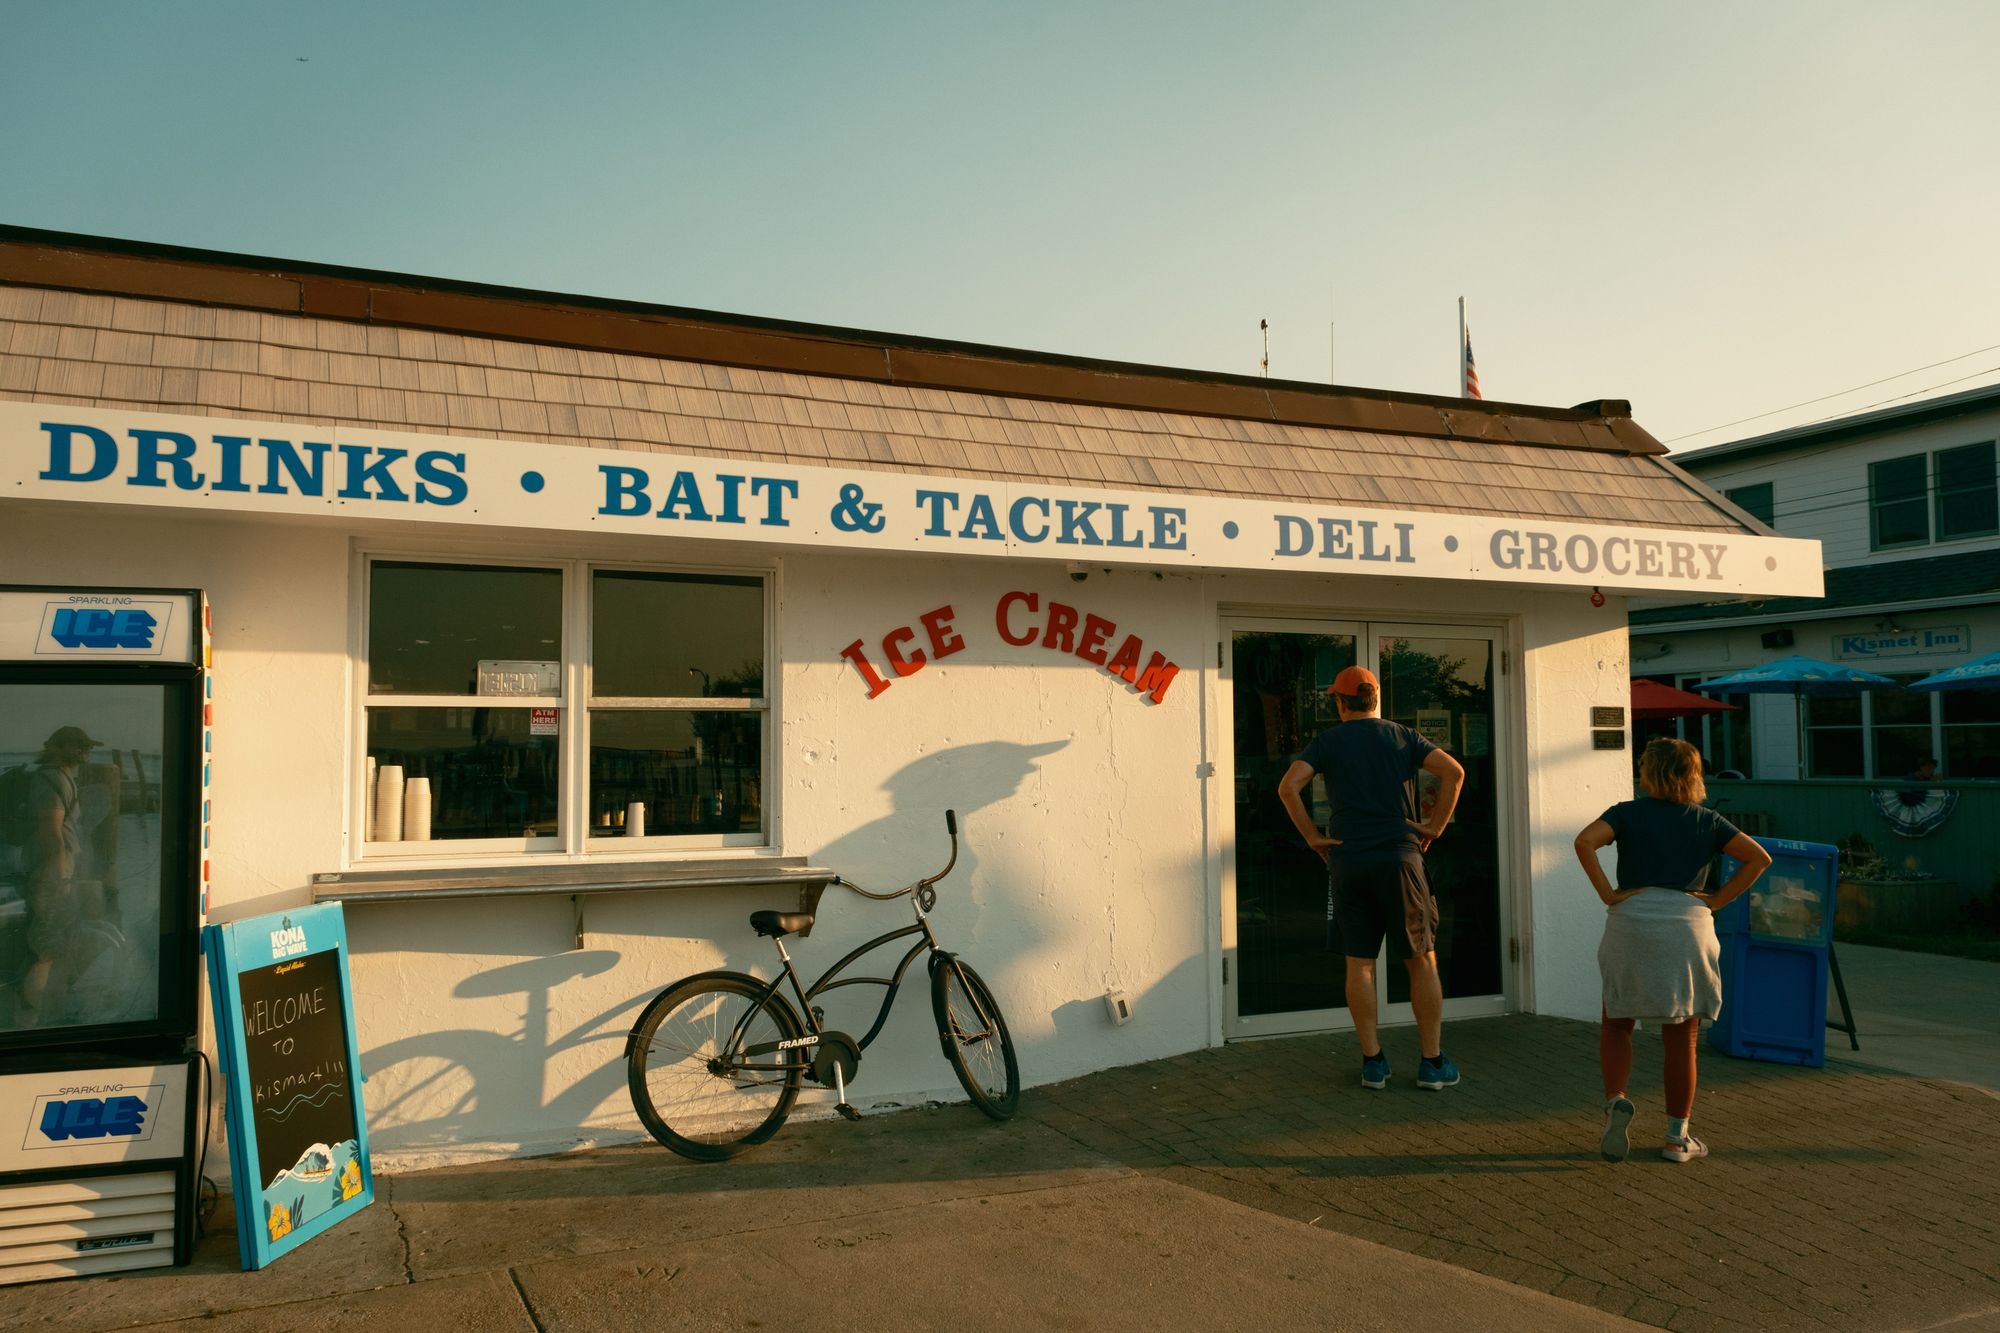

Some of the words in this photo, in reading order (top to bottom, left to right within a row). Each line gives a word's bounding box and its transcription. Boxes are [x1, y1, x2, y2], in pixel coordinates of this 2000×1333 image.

[39, 421, 469, 507] DRINKS
[597, 464, 799, 527] BAIT
[830, 482, 886, 534] &
[915, 489, 1187, 551] TACKLE
[1273, 514, 1416, 564] DELI
[1488, 528, 1729, 582] GROCERY
[68, 596, 132, 605] SPARKLING
[51, 608, 158, 648] ICE
[841, 605, 965, 700] ICE
[996, 590, 1182, 705] CREAM
[1842, 634, 1918, 654] Kismet
[1924, 630, 1960, 648] Inn
[271, 925, 306, 948] KONA
[272, 947, 287, 959] BIG
[286, 941, 308, 955] WAVE
[242, 986, 327, 1036] WELCOME
[272, 1037, 294, 1055] TO
[778, 1035, 819, 1050] FRAMED
[58, 1083, 124, 1096] SPARKLING
[40, 1095, 148, 1141] ICE
